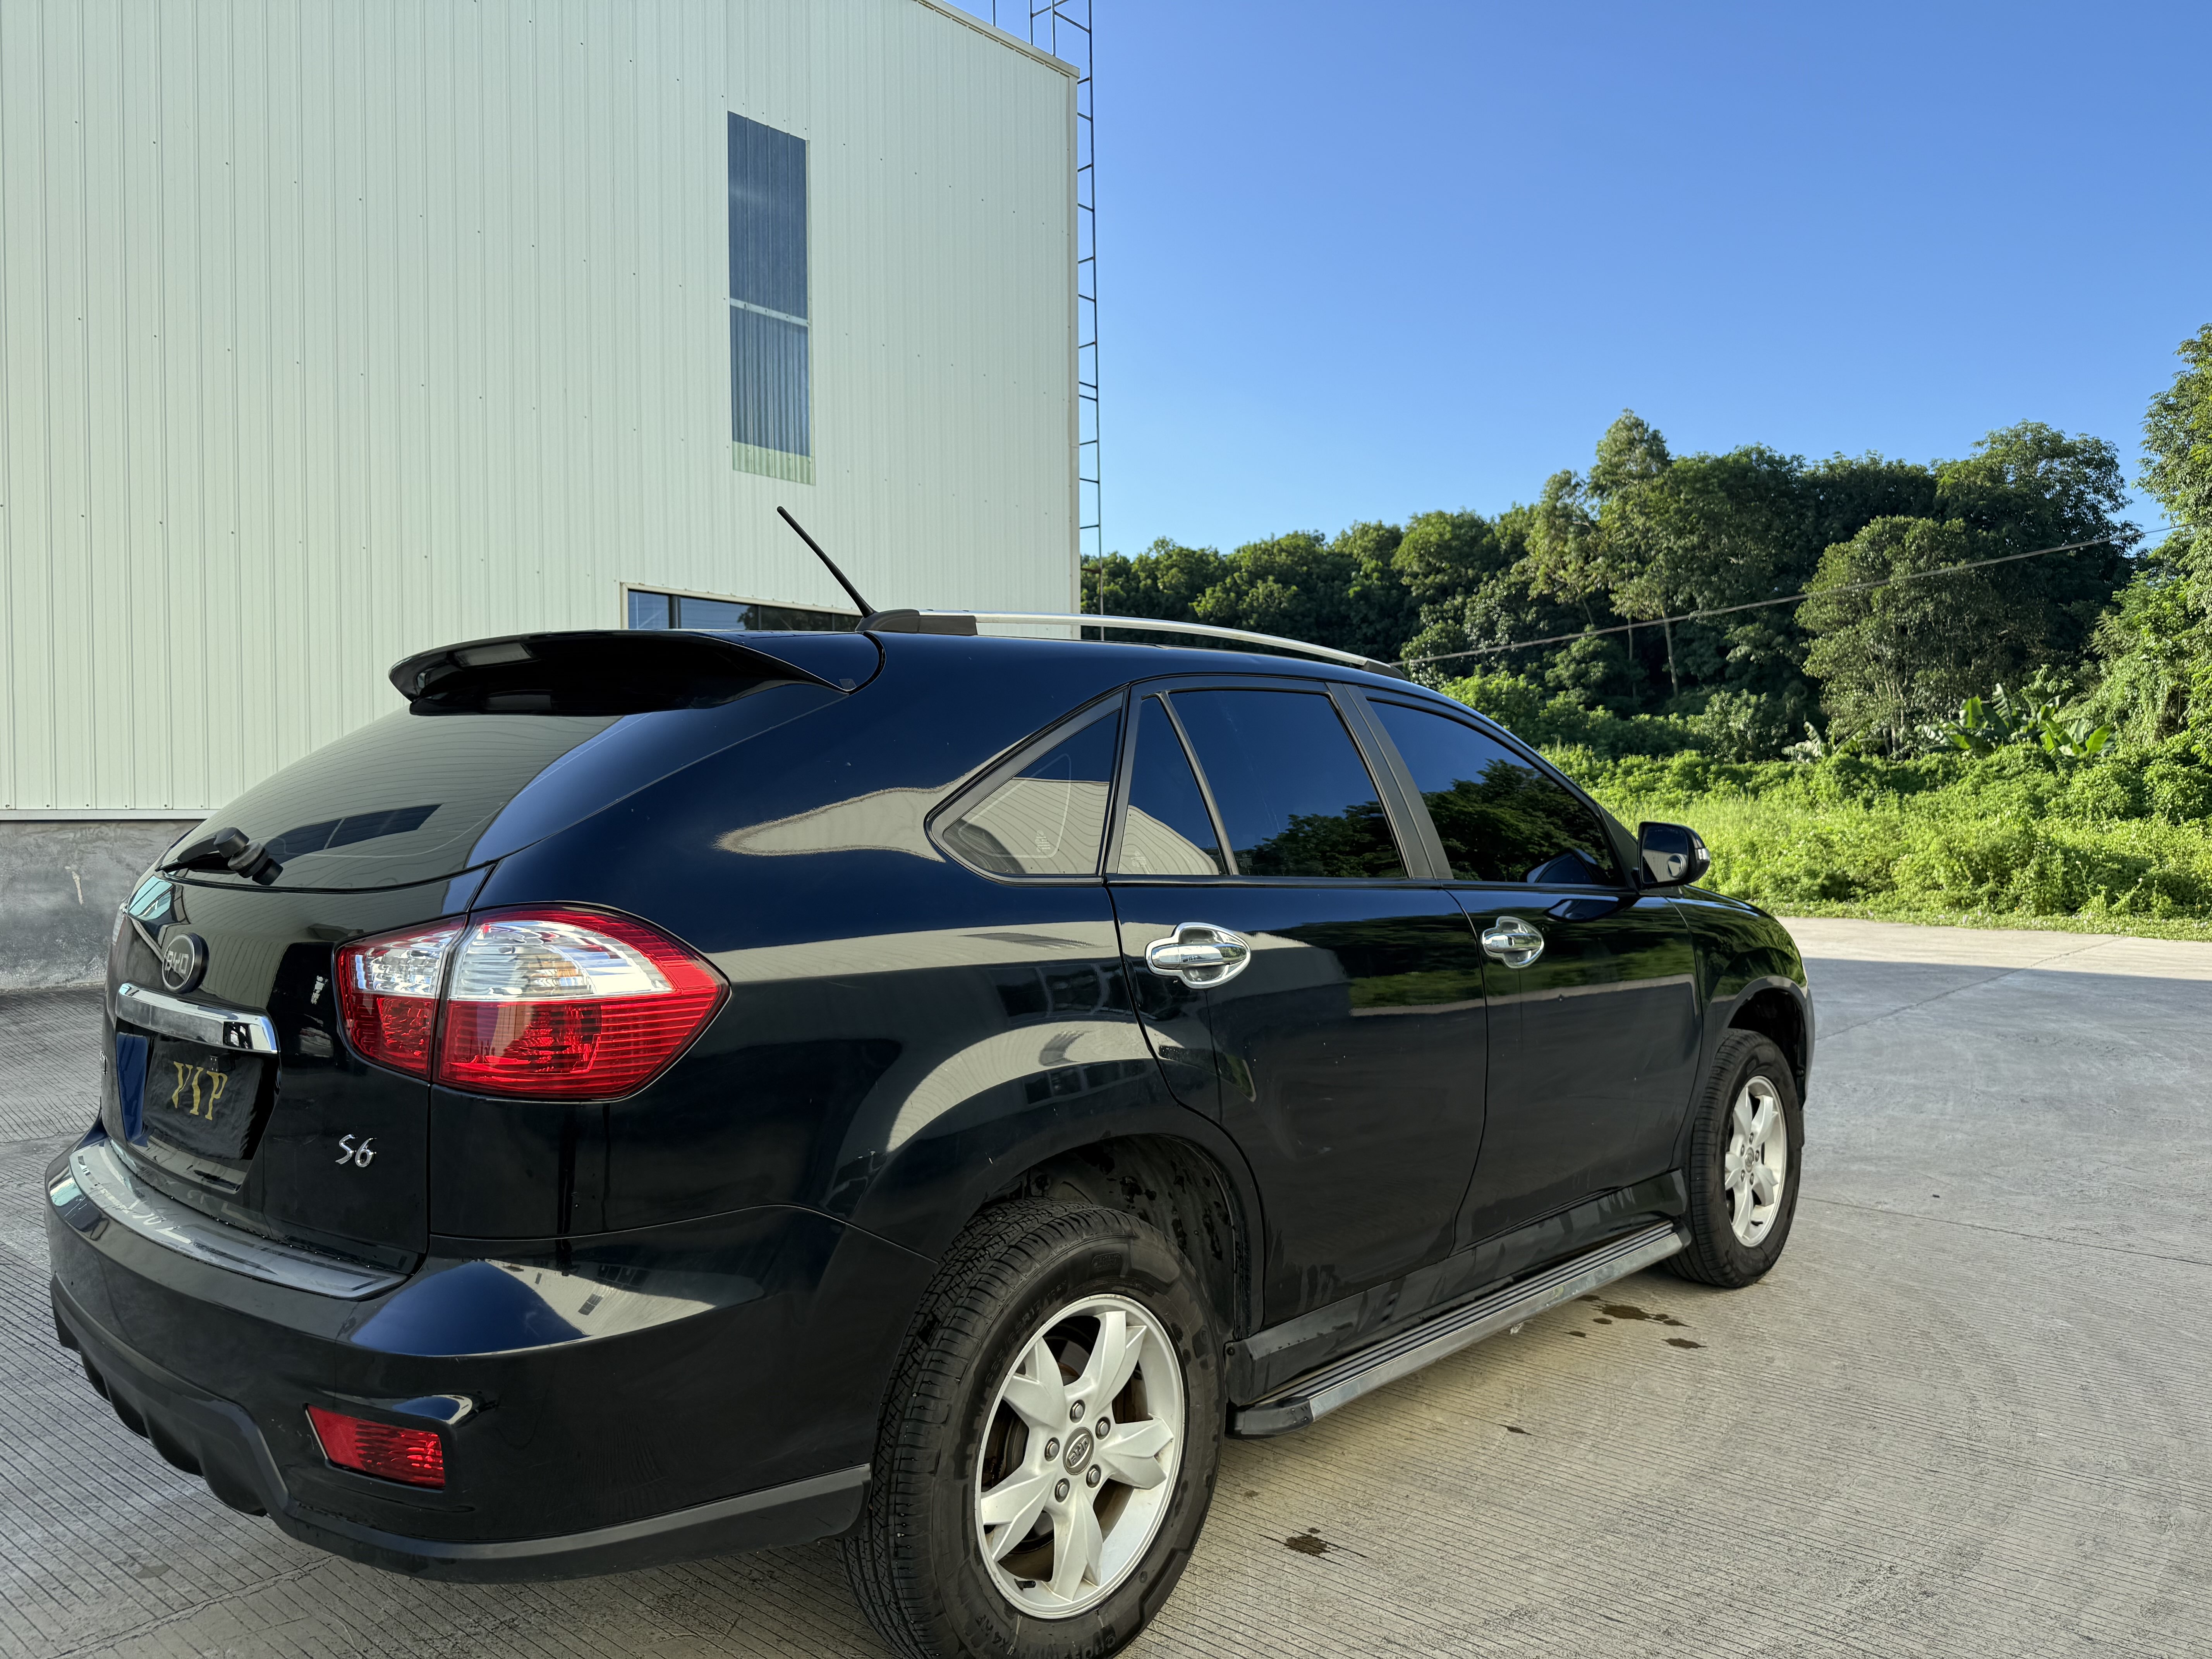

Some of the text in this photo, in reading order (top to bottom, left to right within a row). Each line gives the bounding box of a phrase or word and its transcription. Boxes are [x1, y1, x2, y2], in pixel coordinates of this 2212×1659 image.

[165, 950, 189, 974] BYD
[172, 1061, 228, 1120] VIP
[335, 1134, 375, 1167] S6
[1068, 1438, 1088, 1465] BYD
